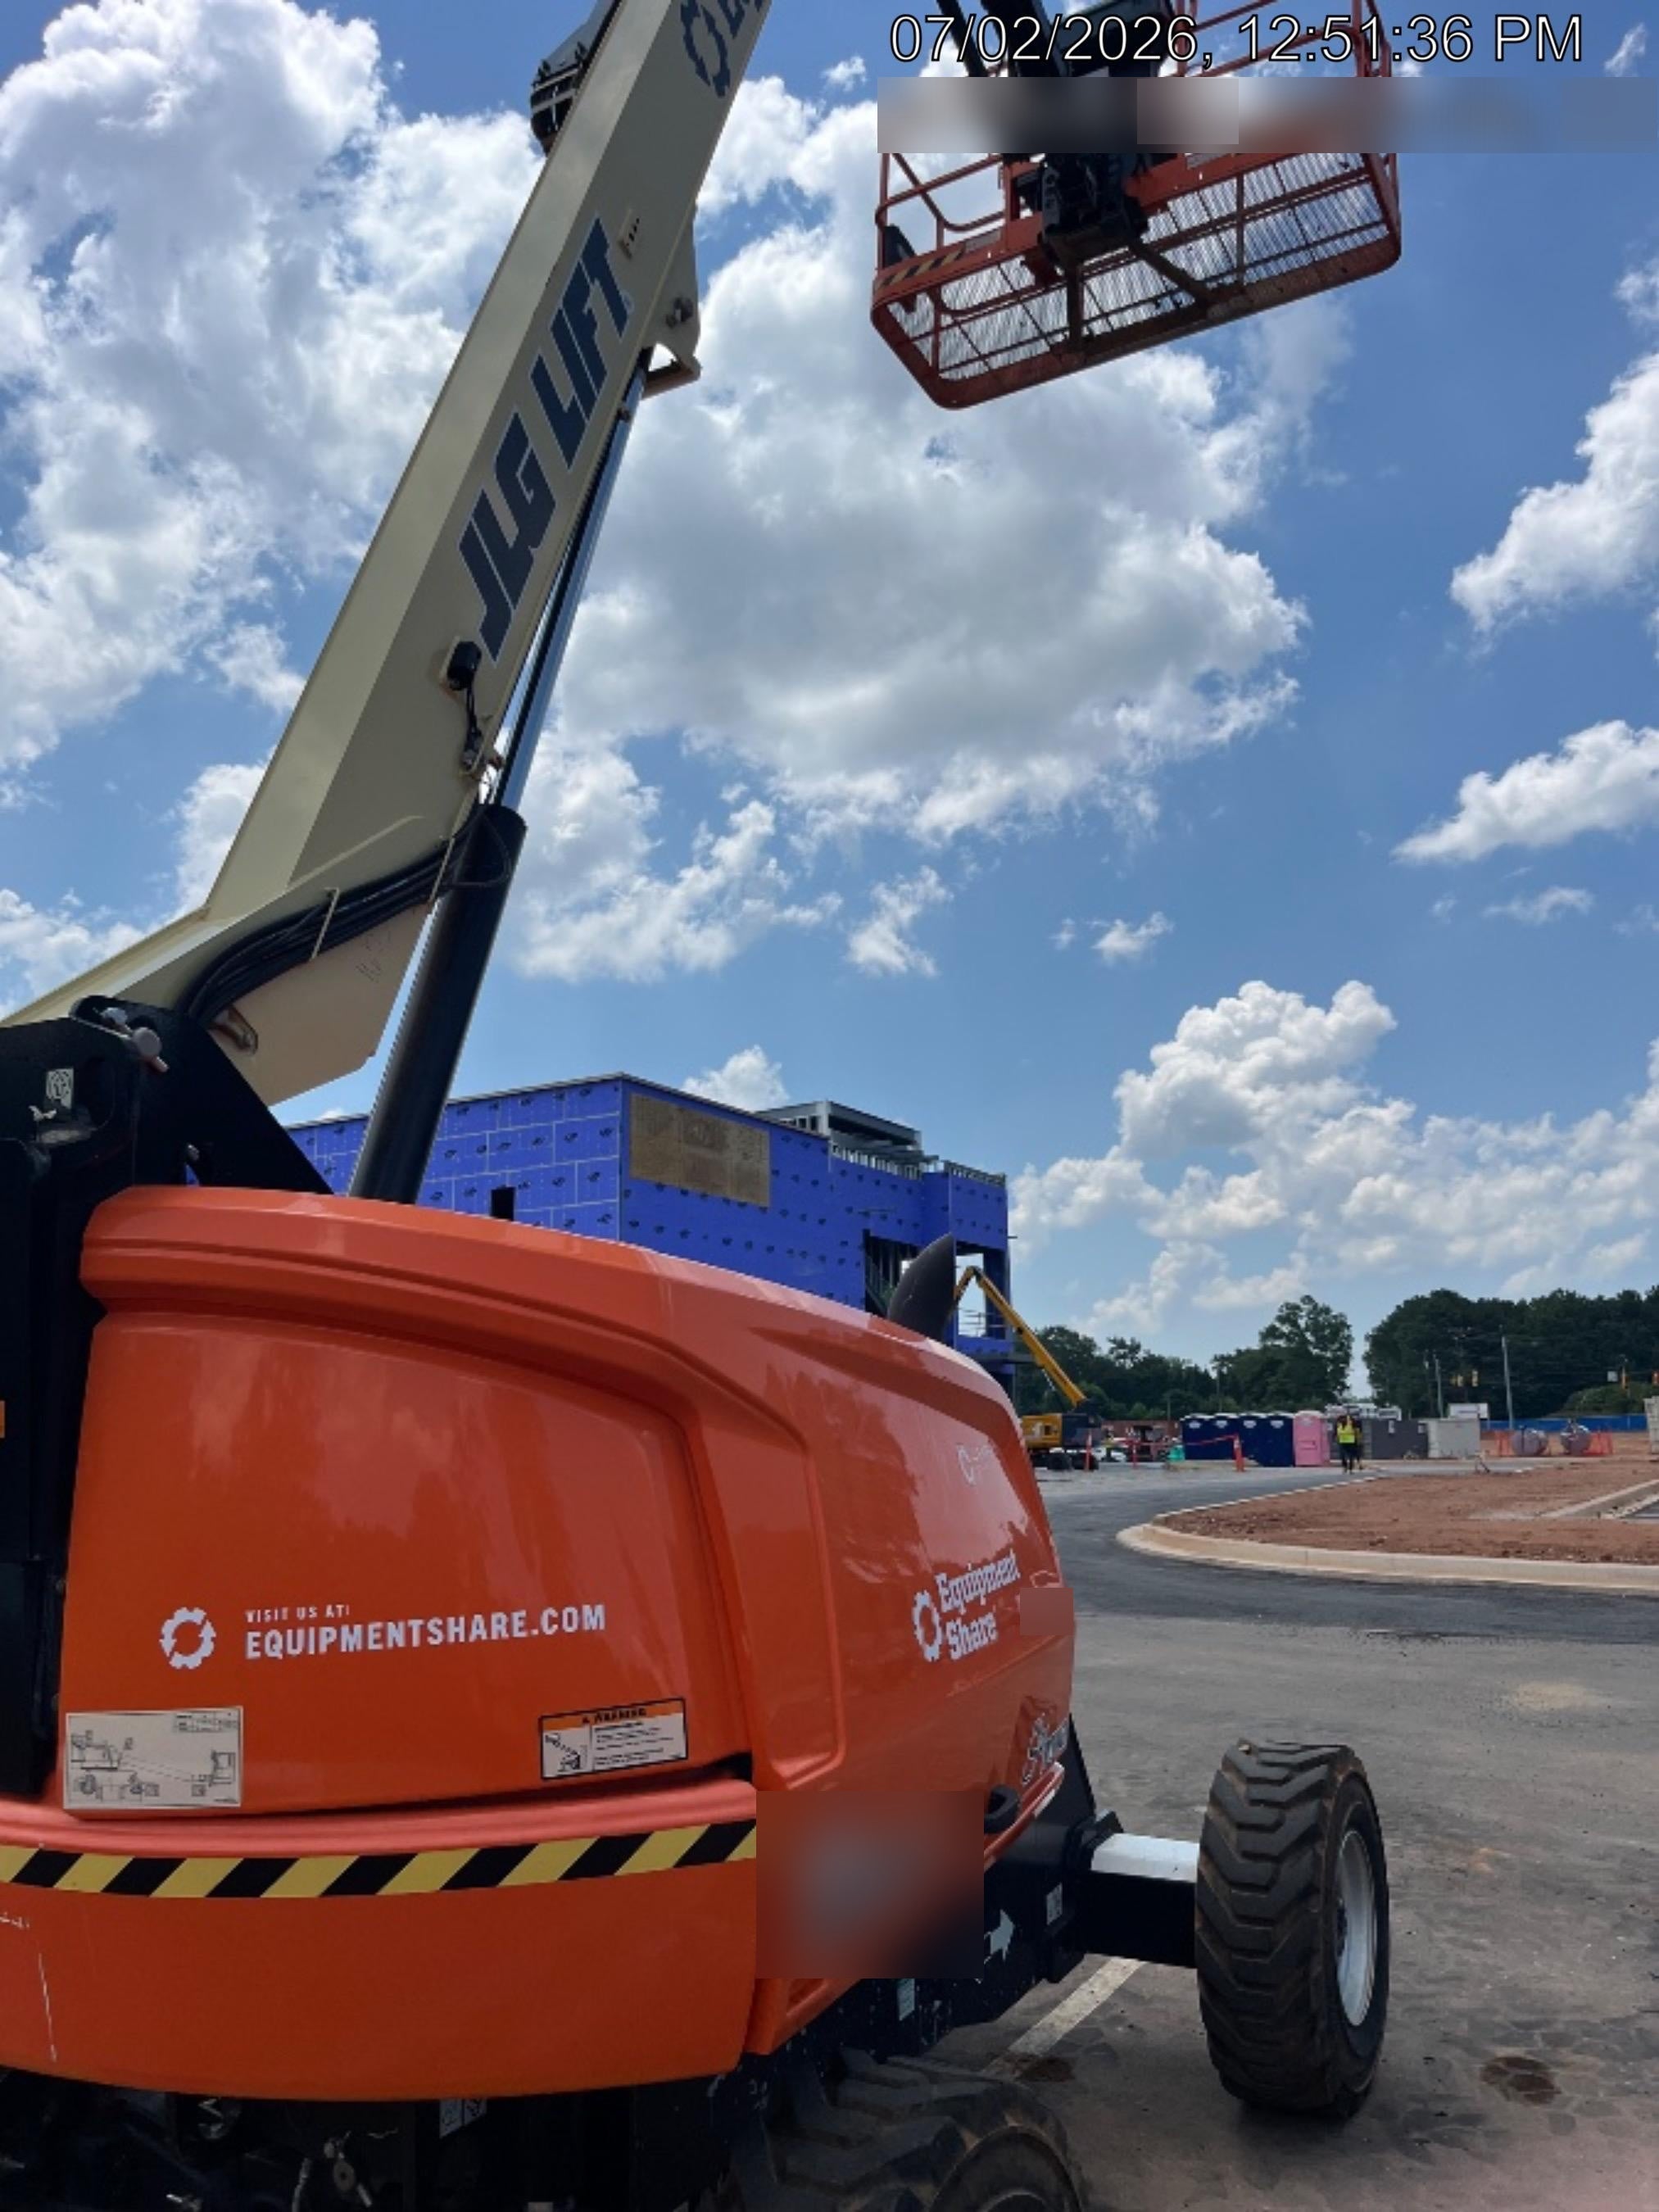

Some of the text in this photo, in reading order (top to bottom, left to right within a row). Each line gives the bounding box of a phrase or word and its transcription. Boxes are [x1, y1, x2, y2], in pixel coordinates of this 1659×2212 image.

[459, 216, 630, 662] JLG LIFT
[935, 1548, 1021, 1615] Equipment
[245, 1608, 288, 1624] VISIT
[297, 1606, 318, 1620] US
[246, 1603, 606, 1660] EQUIPMENTSHARE.COM
[945, 1611, 998, 1660] Share
